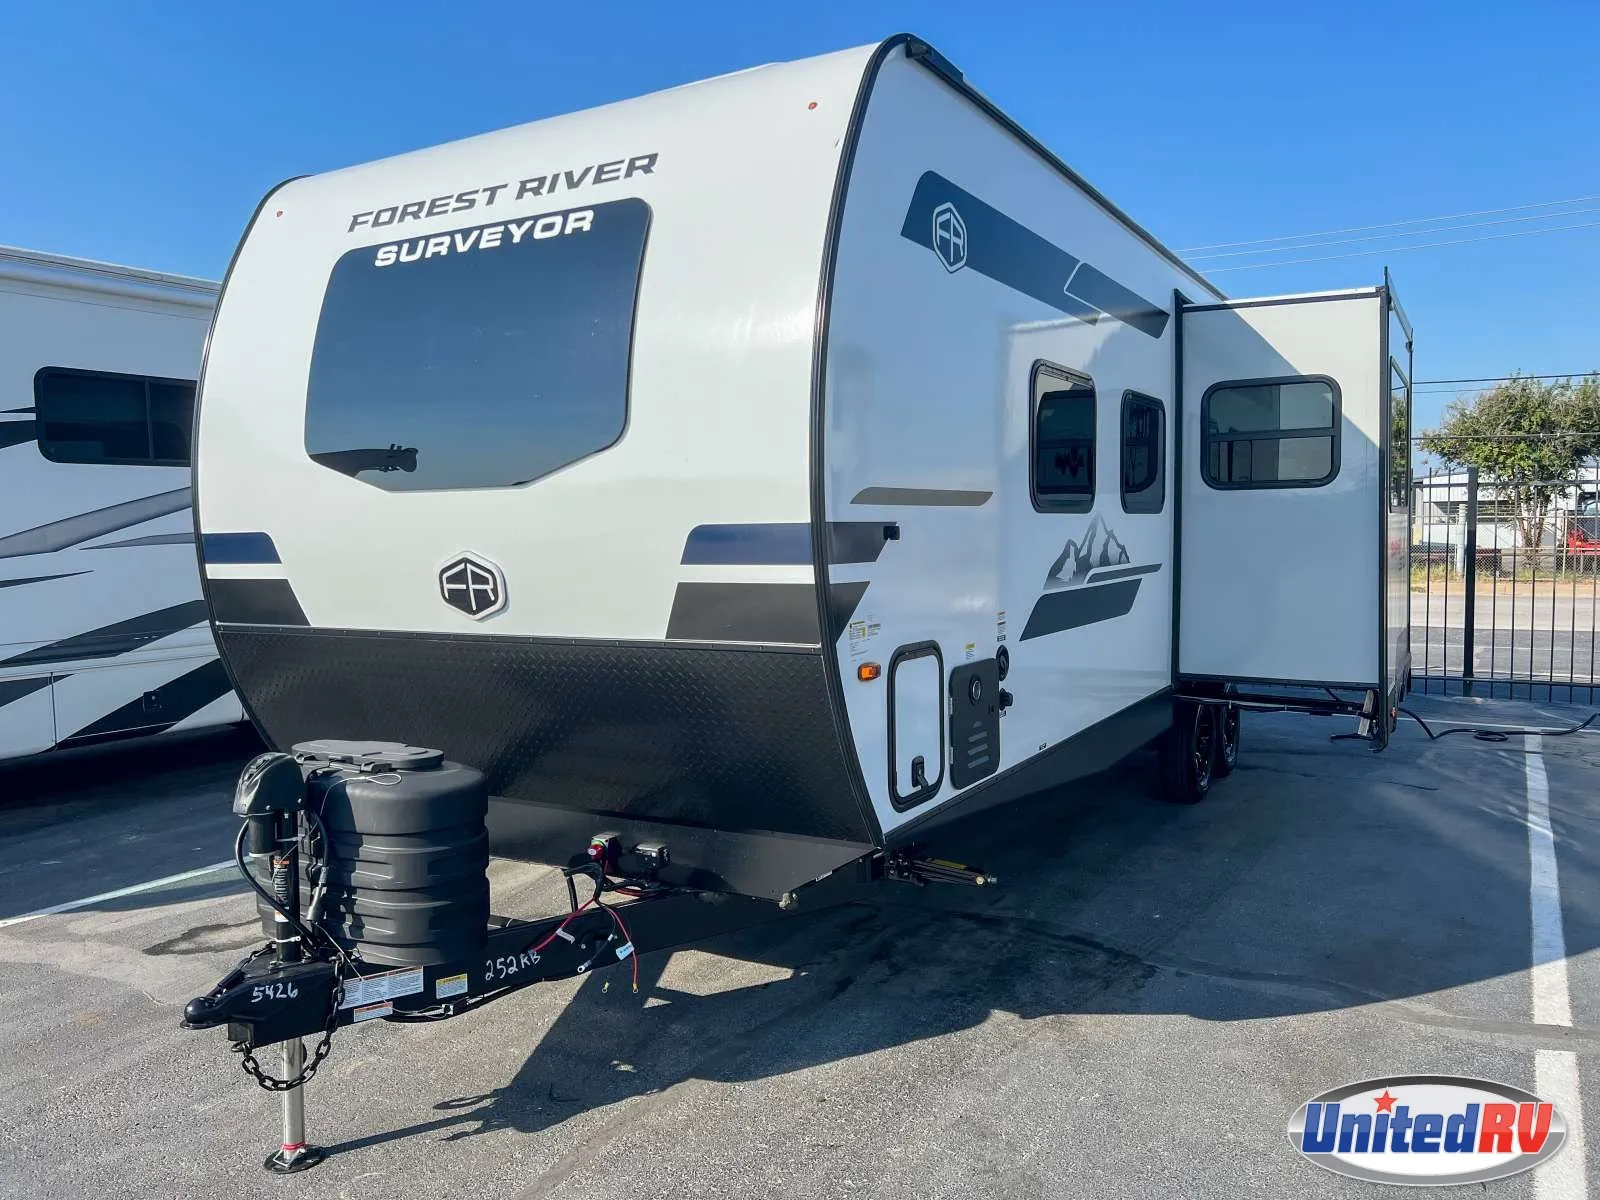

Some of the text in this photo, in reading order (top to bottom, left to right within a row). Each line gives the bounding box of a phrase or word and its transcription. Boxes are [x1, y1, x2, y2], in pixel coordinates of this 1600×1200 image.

[348, 153, 658, 233] FOREST RIVER
[374, 209, 595, 267] SURVEYOR
[251, 982, 298, 1002] 5426
